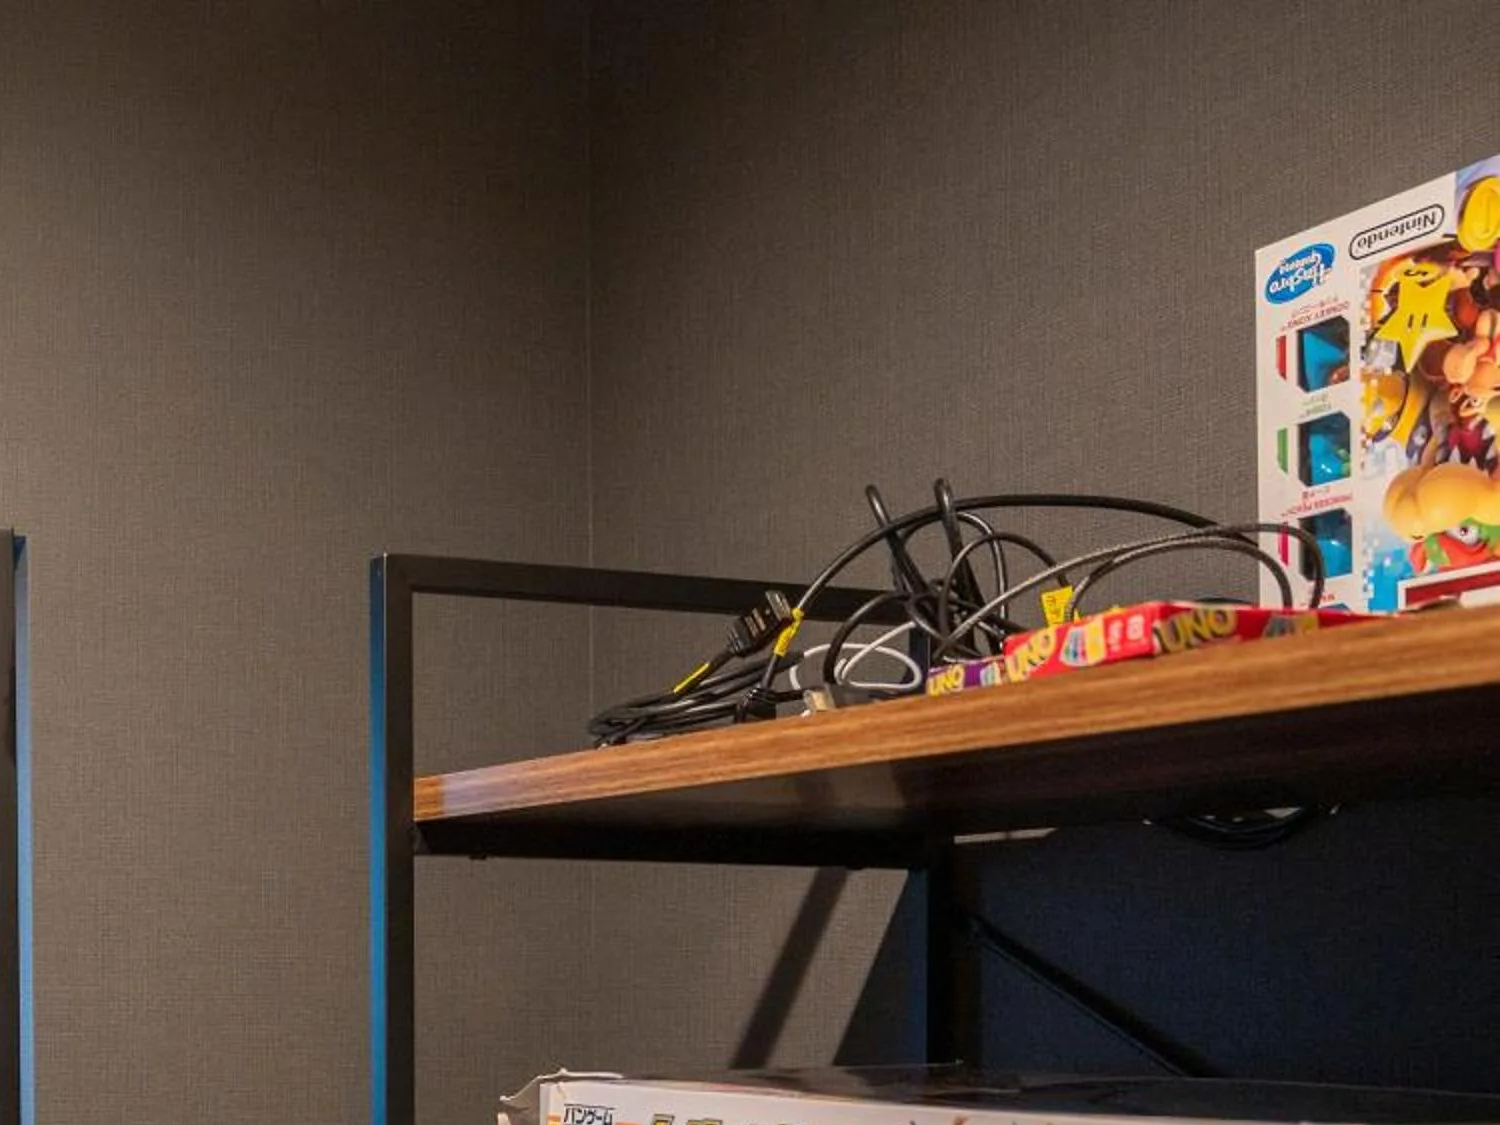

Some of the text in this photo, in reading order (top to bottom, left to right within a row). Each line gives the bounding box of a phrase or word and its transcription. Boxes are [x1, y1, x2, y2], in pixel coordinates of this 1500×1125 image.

[1357, 211, 1438, 249] Nintendo
[1270, 263, 1325, 293] Hasbro
[1157, 608, 1237, 653] UNO
[1006, 627, 1057, 682] UNO
[927, 666, 966, 697] UNO
